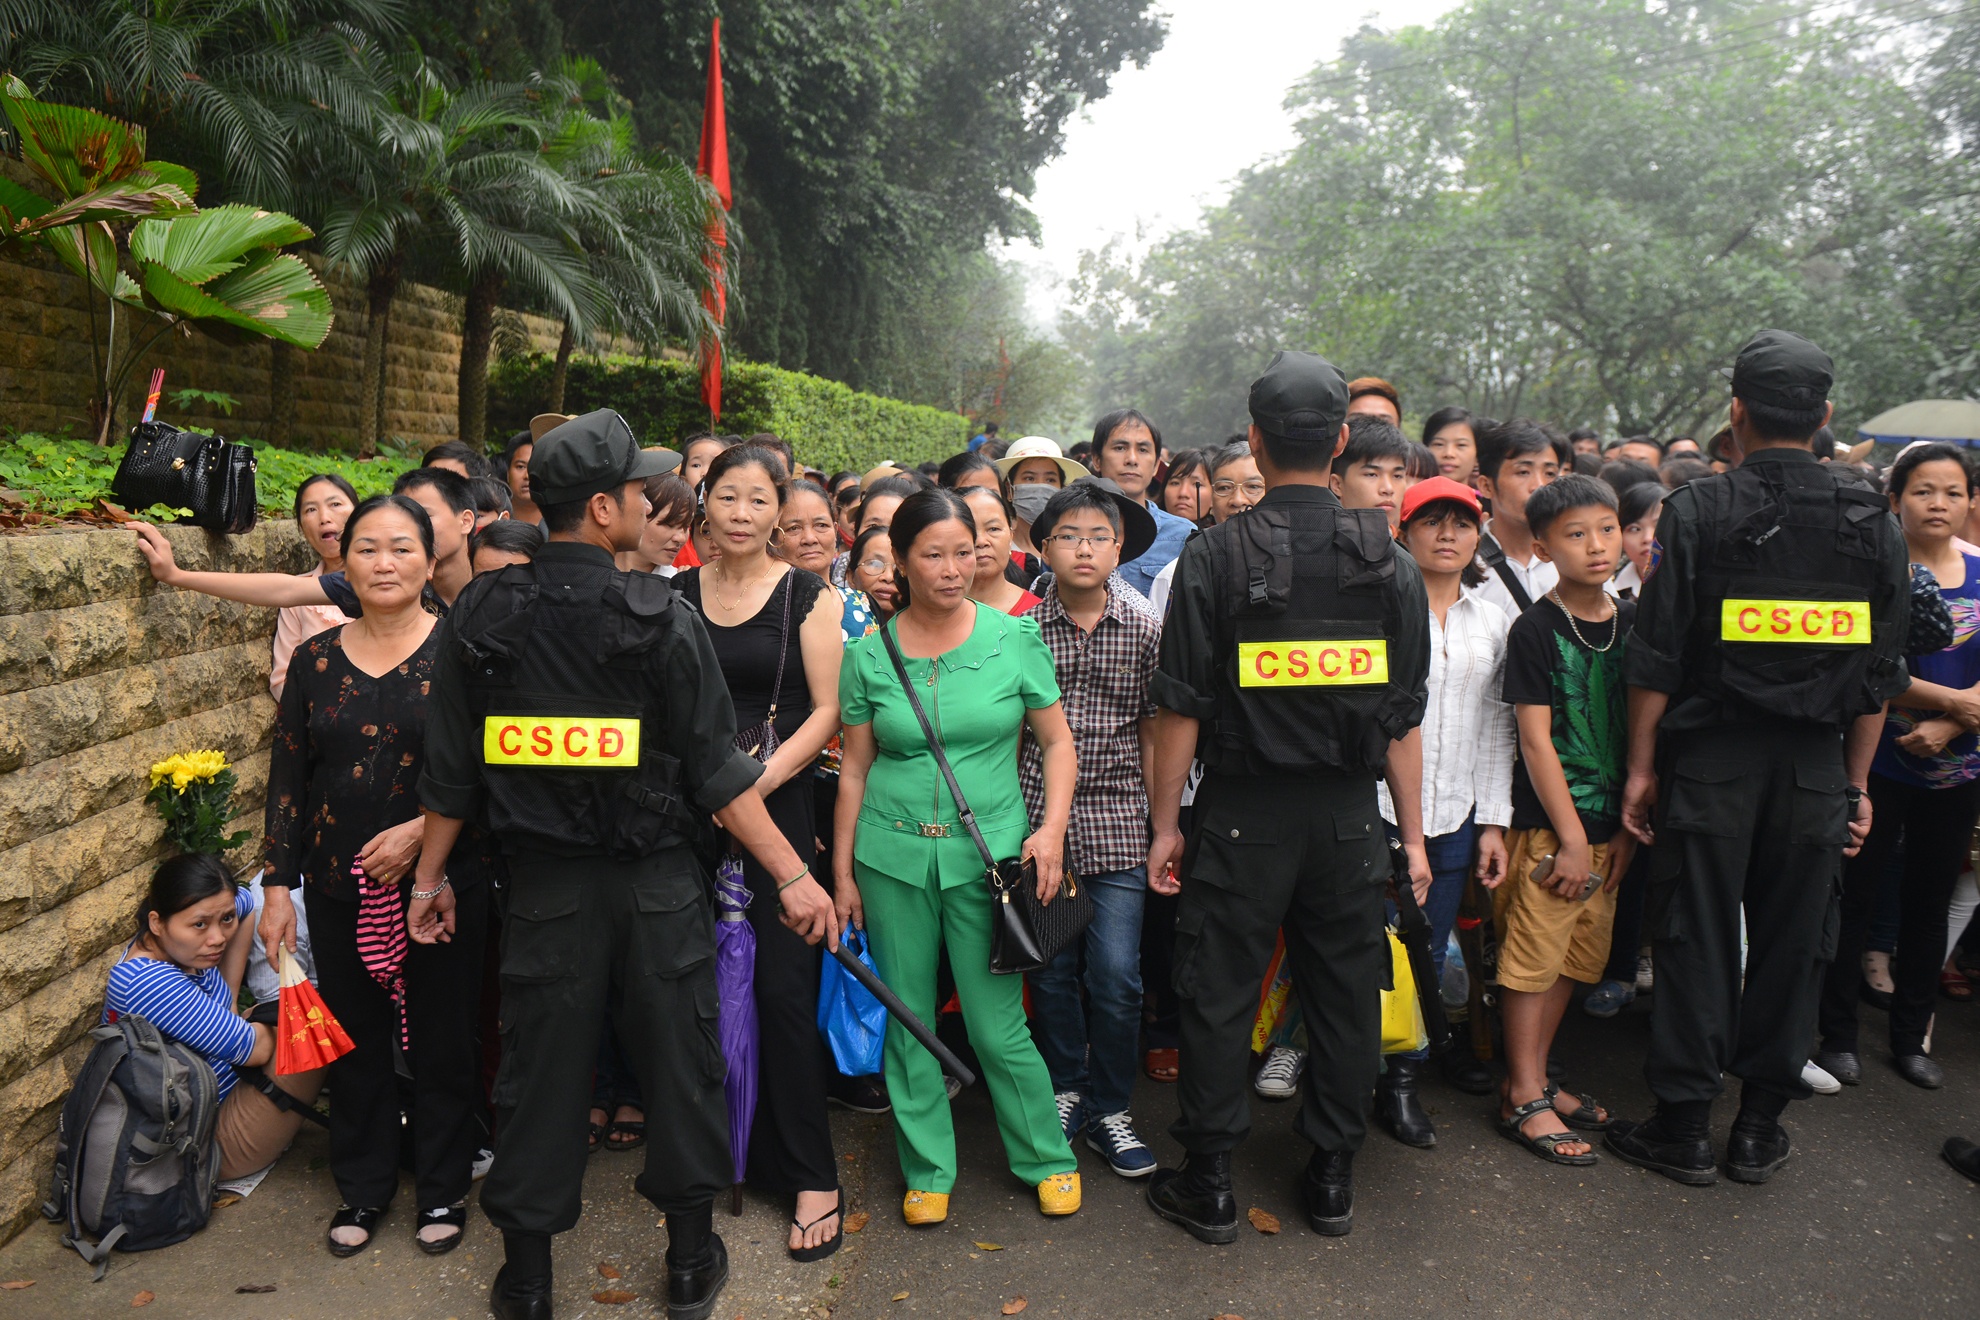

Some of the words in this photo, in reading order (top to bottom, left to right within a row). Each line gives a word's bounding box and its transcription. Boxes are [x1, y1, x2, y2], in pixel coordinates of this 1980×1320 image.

[1738, 607, 1855, 637] CSCĐ
[1255, 647, 1373, 679] CSCĐ
[498, 724, 624, 758] CSCĐ
